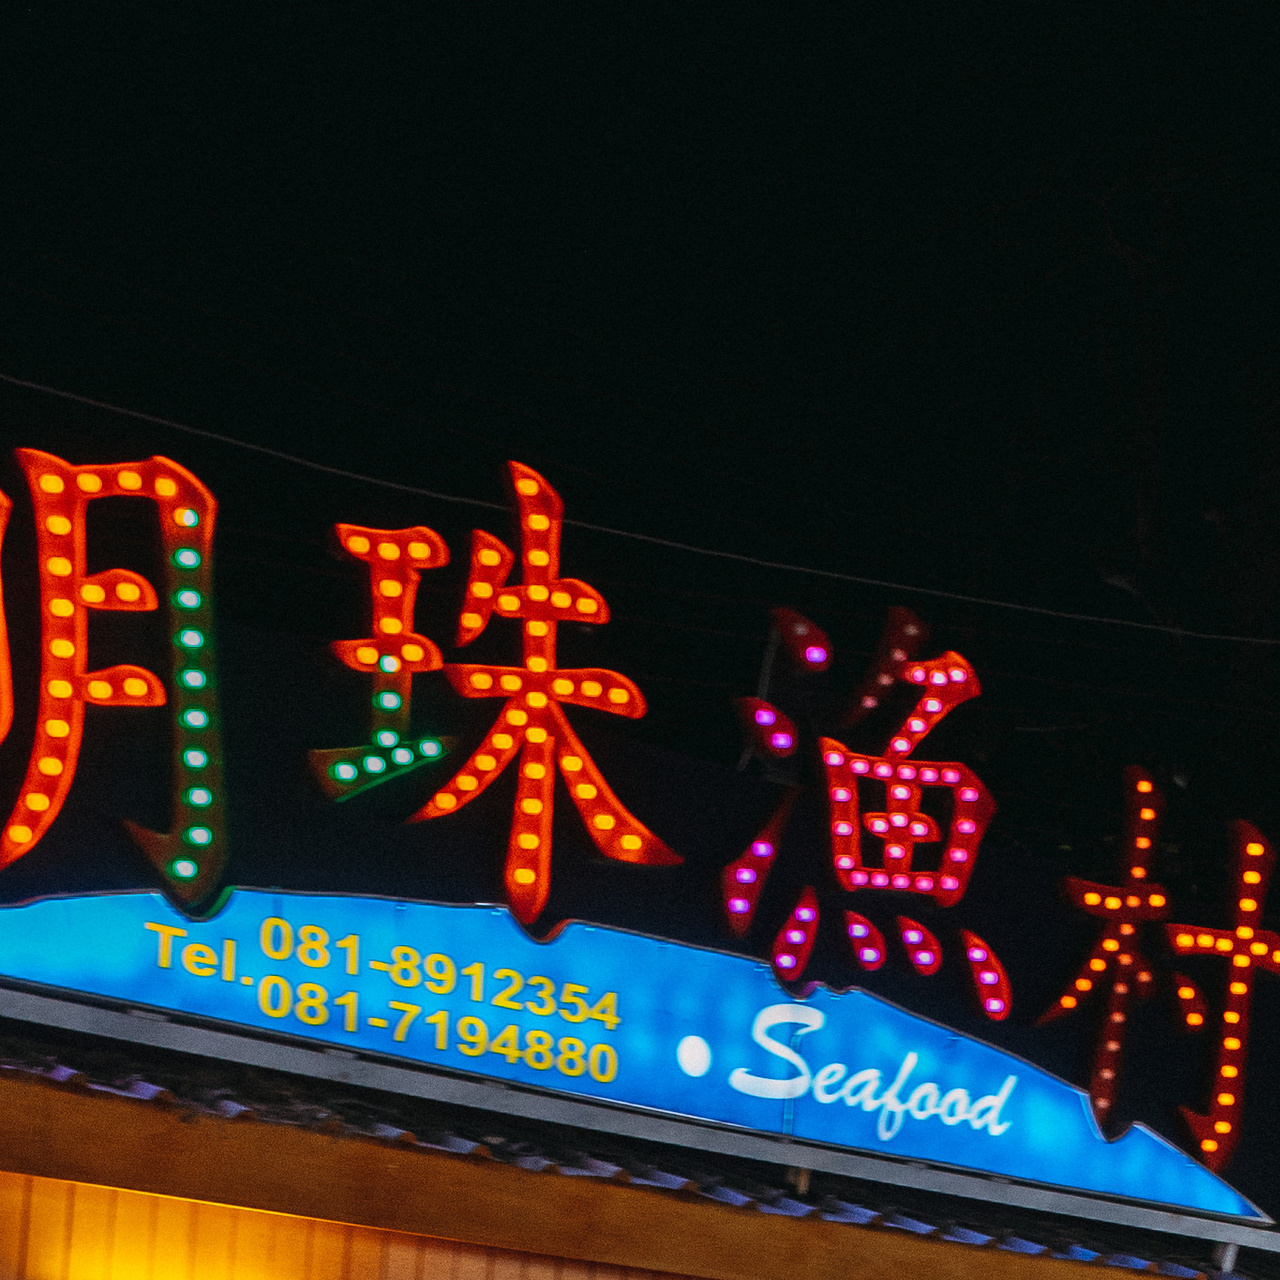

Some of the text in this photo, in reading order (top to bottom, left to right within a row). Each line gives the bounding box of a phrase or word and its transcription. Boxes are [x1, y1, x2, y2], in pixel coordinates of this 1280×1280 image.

[145, 916, 621, 1030] Tel. 081-8912354
[257, 974, 619, 1084] 081-7194880
[728, 1003, 1018, 1141] Seafood
